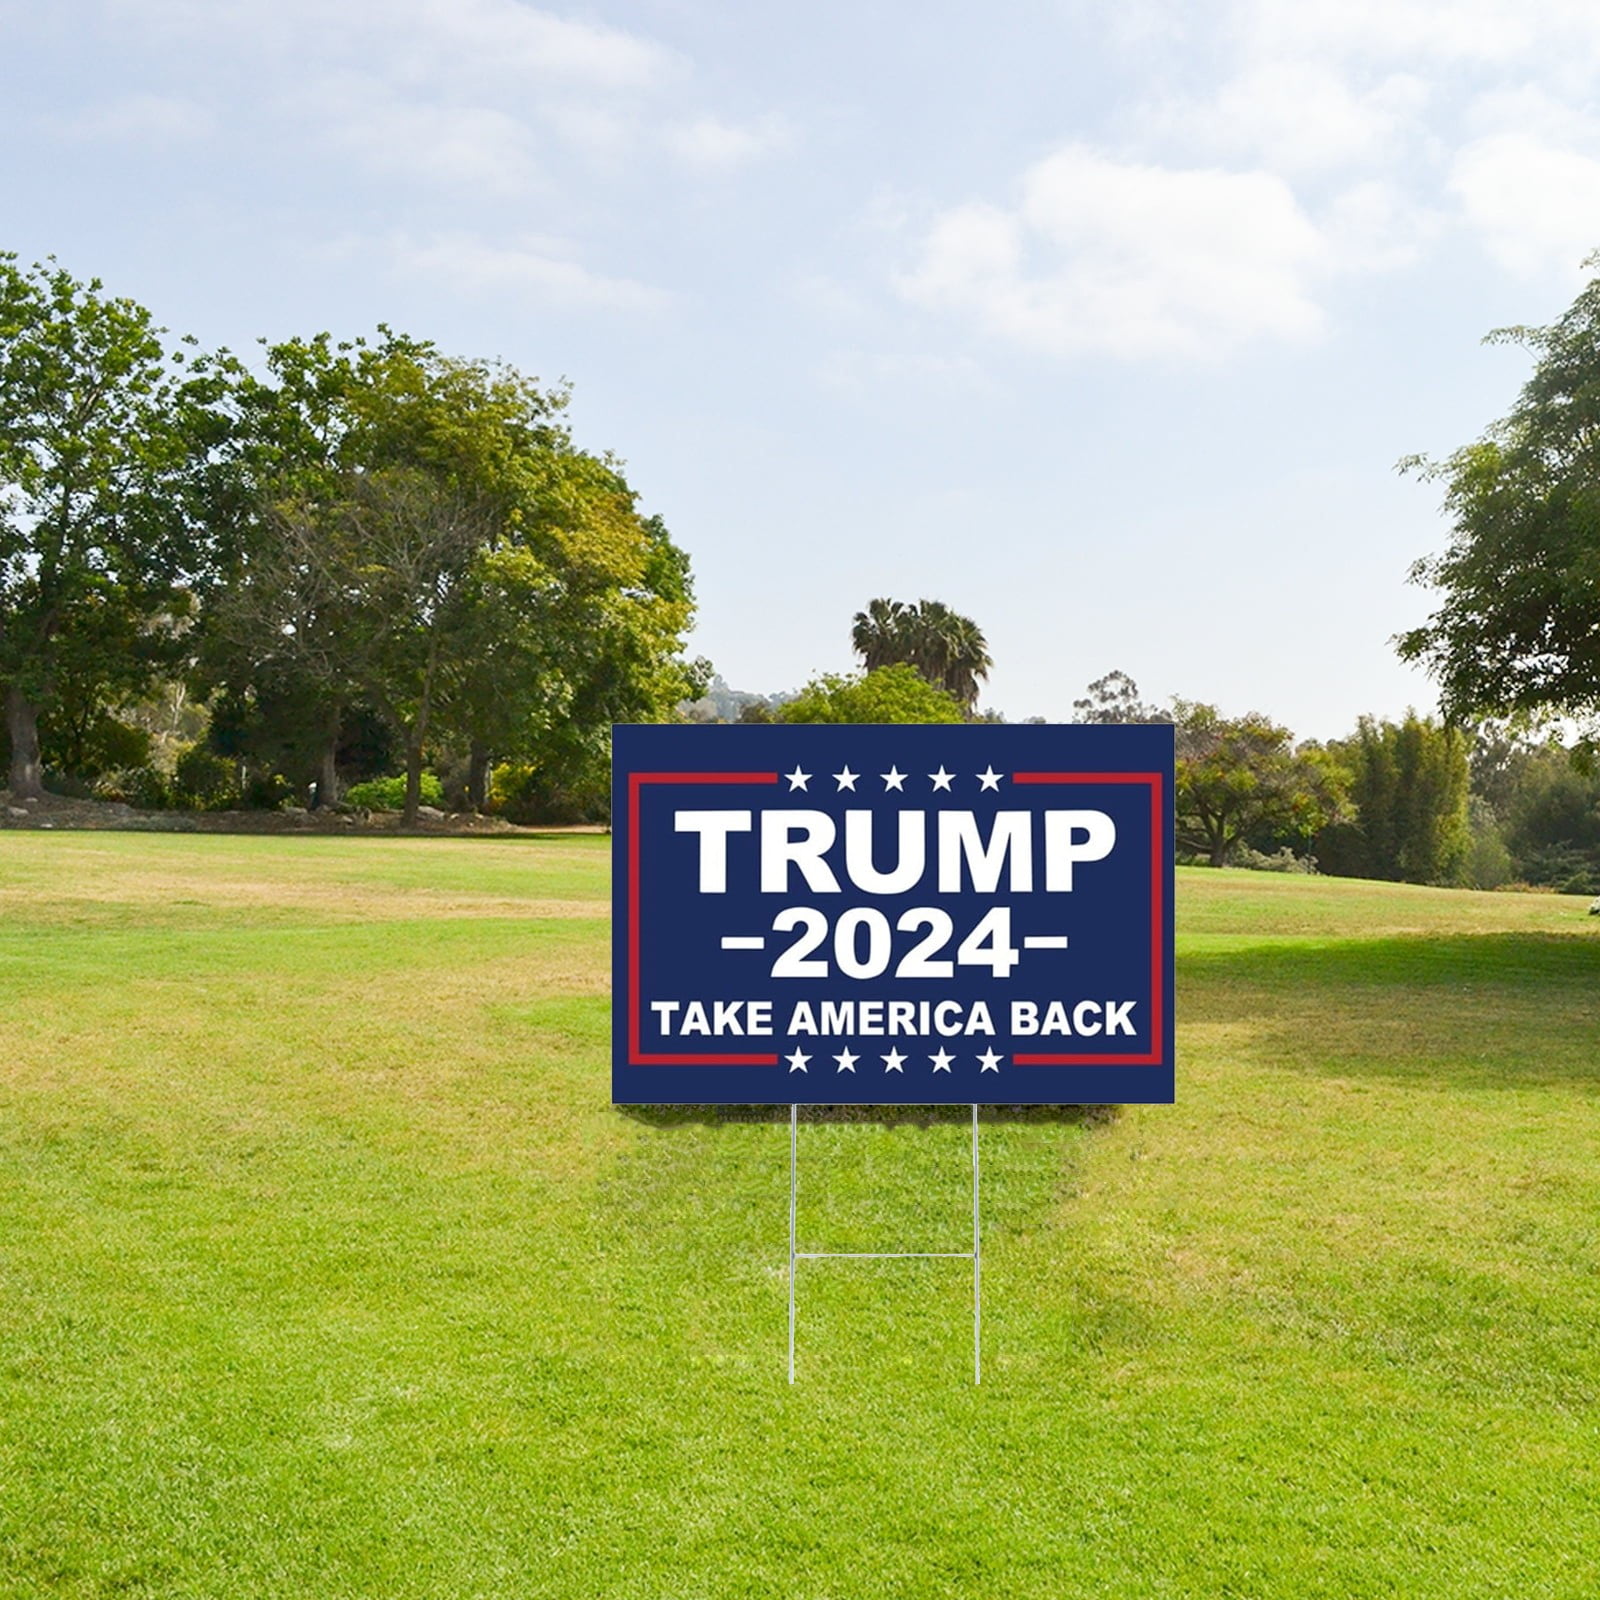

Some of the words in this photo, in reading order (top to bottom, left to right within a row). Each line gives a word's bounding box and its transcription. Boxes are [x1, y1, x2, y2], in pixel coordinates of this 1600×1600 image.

[674, 809, 1116, 895] TRUMP
[650, 1001, 773, 1036] TAKE
[786, 1000, 996, 1037] AMERICA
[1011, 1000, 1137, 1037] BACK
